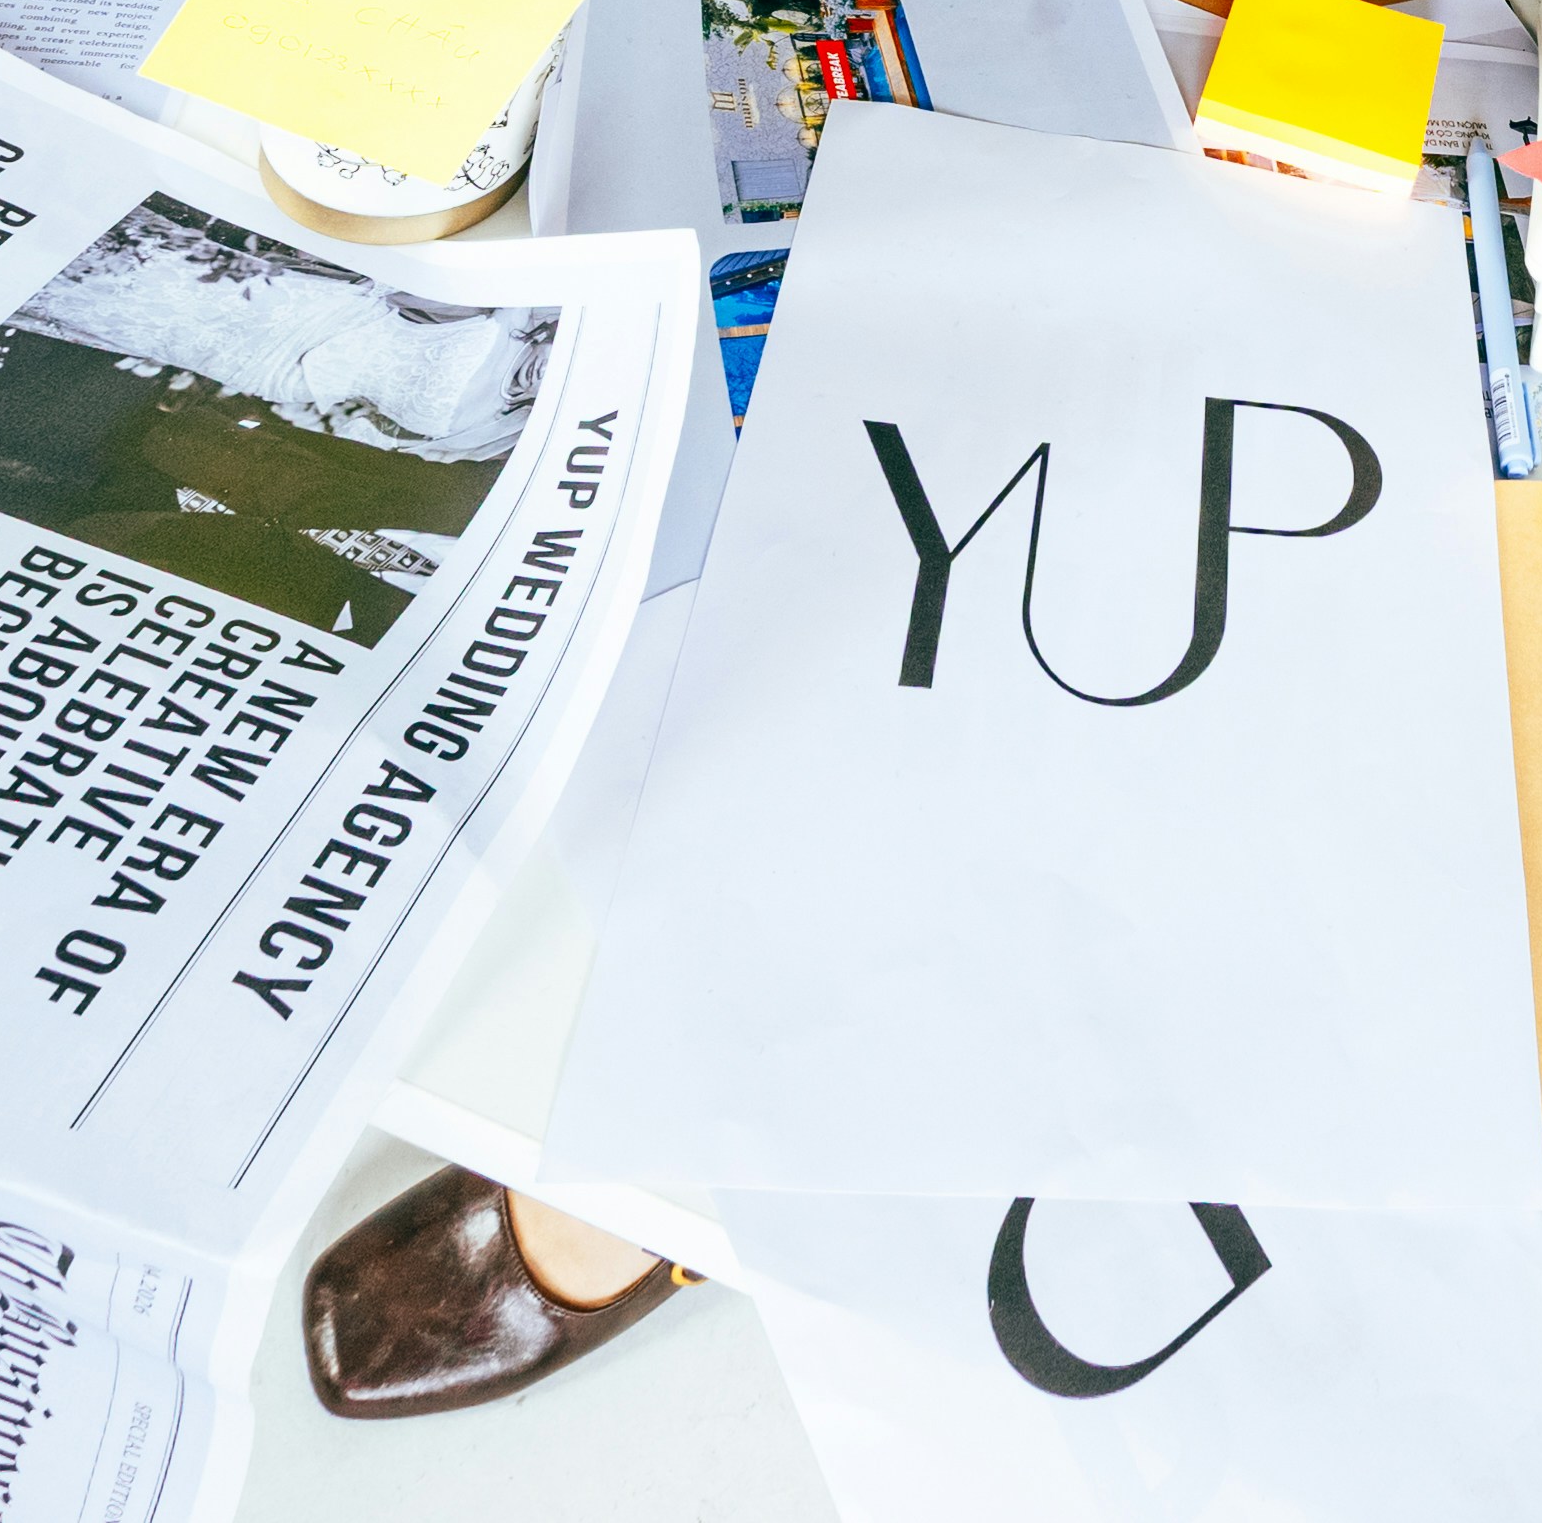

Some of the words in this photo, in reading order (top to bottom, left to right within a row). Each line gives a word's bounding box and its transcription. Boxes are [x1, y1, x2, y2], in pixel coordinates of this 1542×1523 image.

[559, 409, 619, 510] YUP
[75, 570, 133, 618] IS
[862, 396, 1382, 707] YUP
[280, 639, 346, 681] A
[403, 530, 583, 763] WEDDING
[47, 617, 281, 863] CREATIVE
[189, 678, 319, 802] NEW
[92, 798, 225, 917] ERA
[231, 760, 437, 1021] AGENCY
[35, 930, 128, 1017] OF
[123, 1402, 152, 1464] SPECIAL
